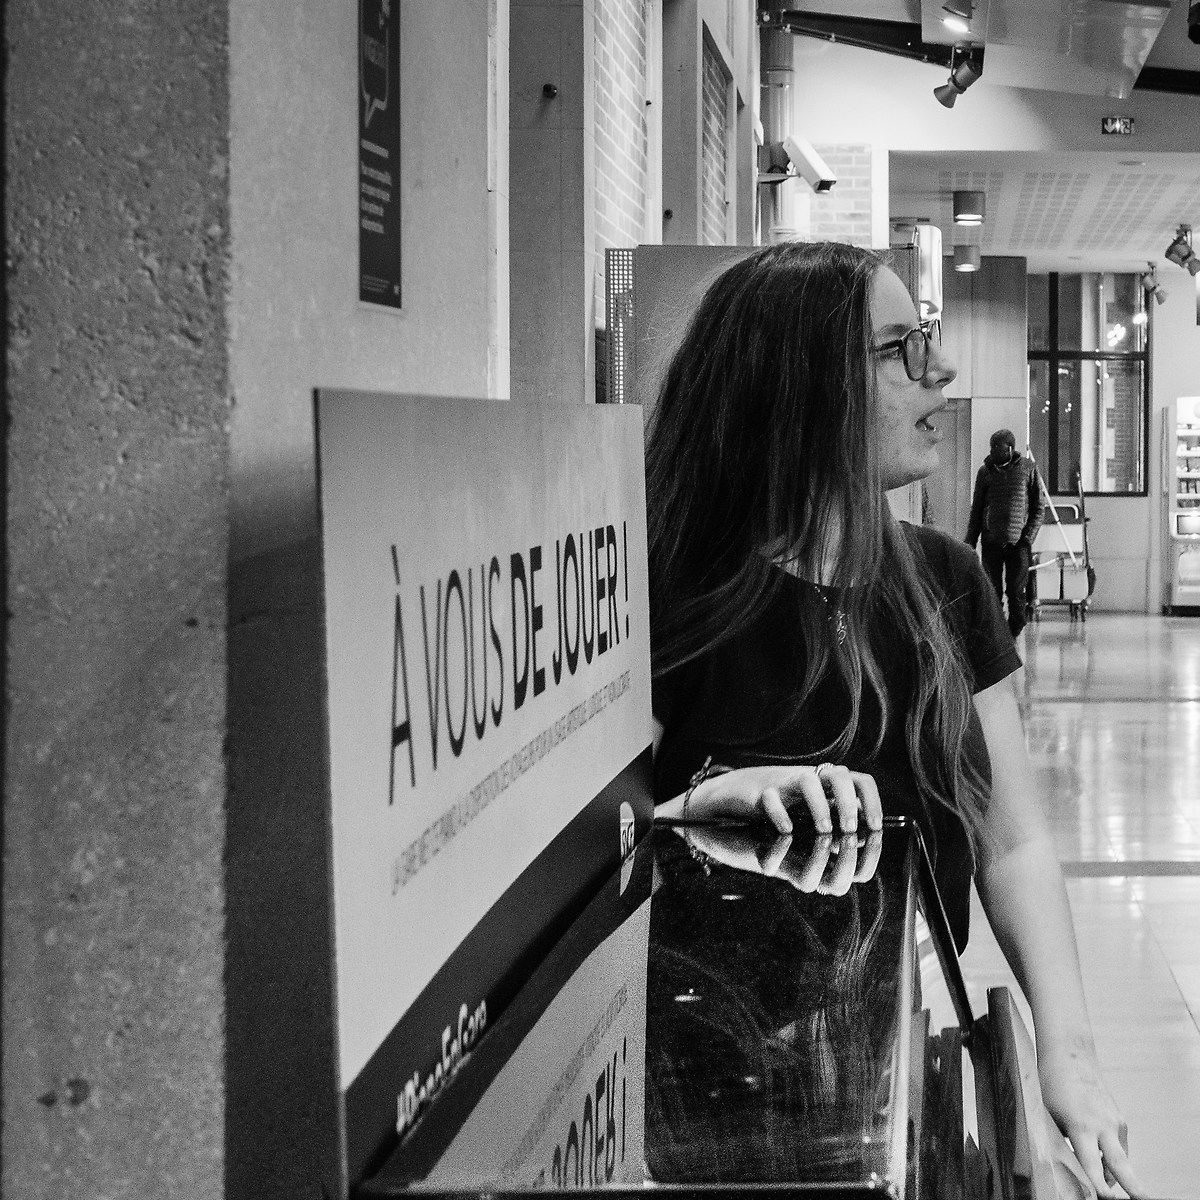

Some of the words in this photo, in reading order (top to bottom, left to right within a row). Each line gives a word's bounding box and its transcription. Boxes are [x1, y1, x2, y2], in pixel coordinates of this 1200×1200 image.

[388, 543, 416, 806] À
[419, 555, 504, 770] VOUS
[510, 545, 546, 711] DE
[552, 524, 620, 686] JOUER
